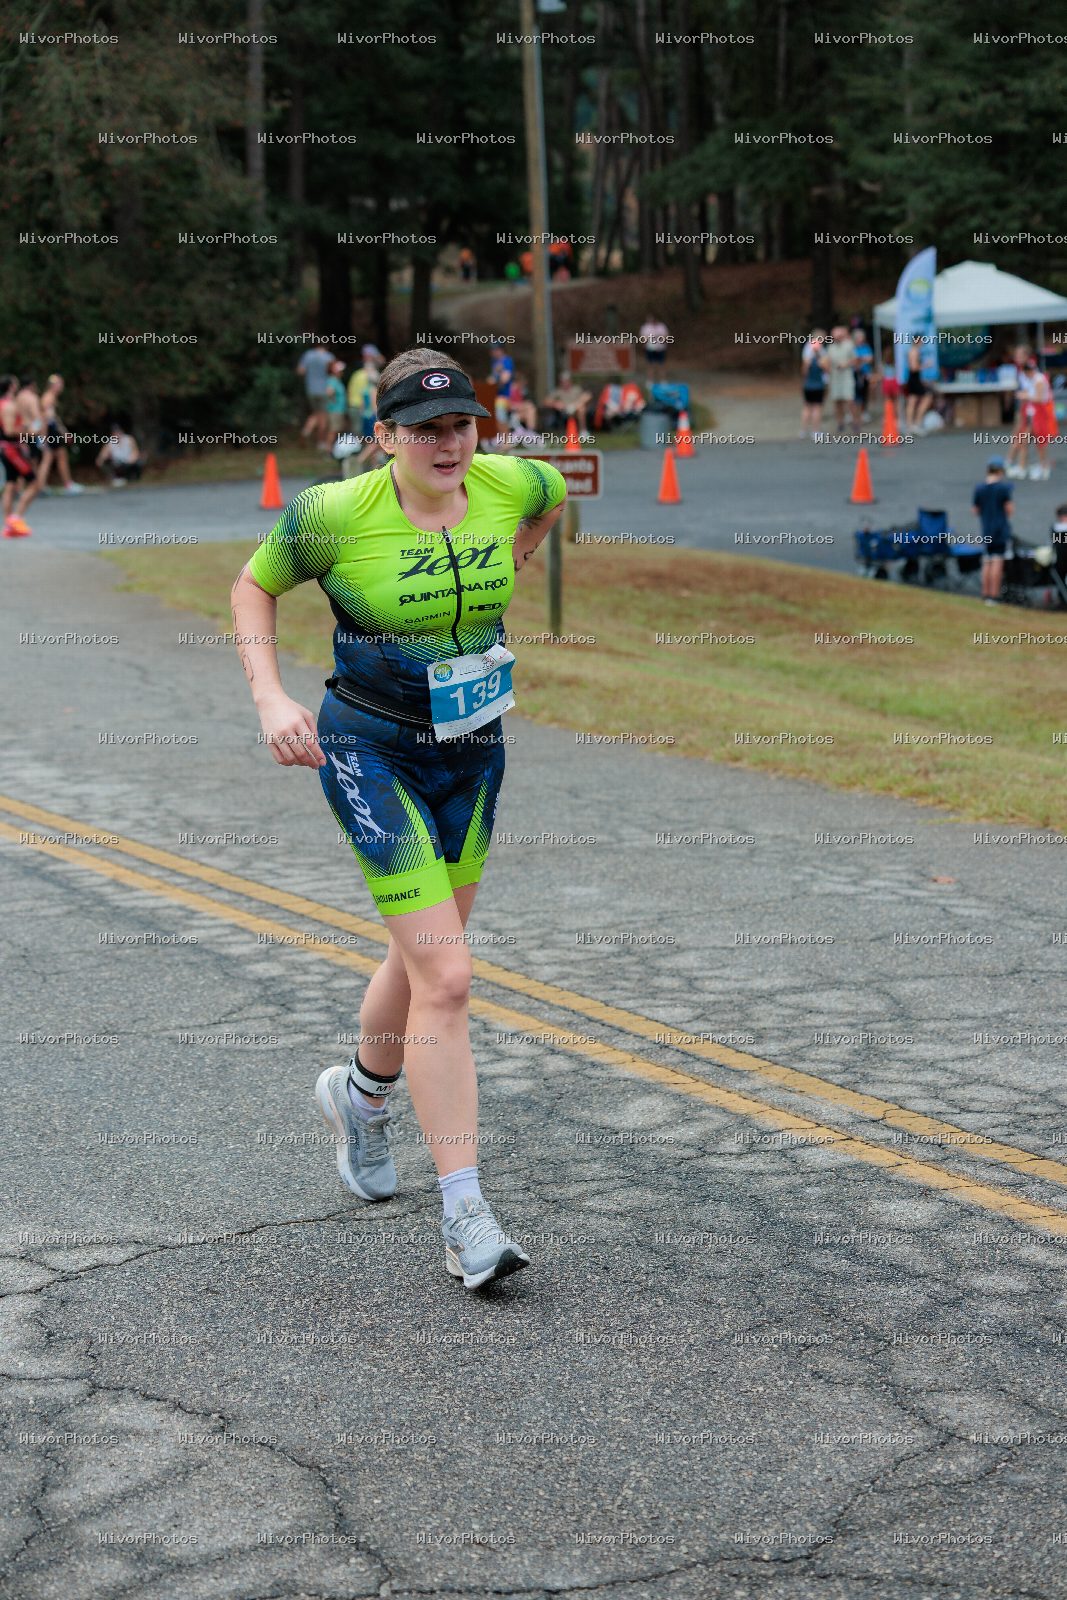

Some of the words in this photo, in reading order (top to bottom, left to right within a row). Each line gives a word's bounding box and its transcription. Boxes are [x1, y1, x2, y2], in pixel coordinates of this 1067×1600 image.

[399, 546, 435, 557] TEAM
[404, 610, 451, 624] GARMIN
[449, 670, 502, 716] 139
[348, 751, 364, 777] TEAM
